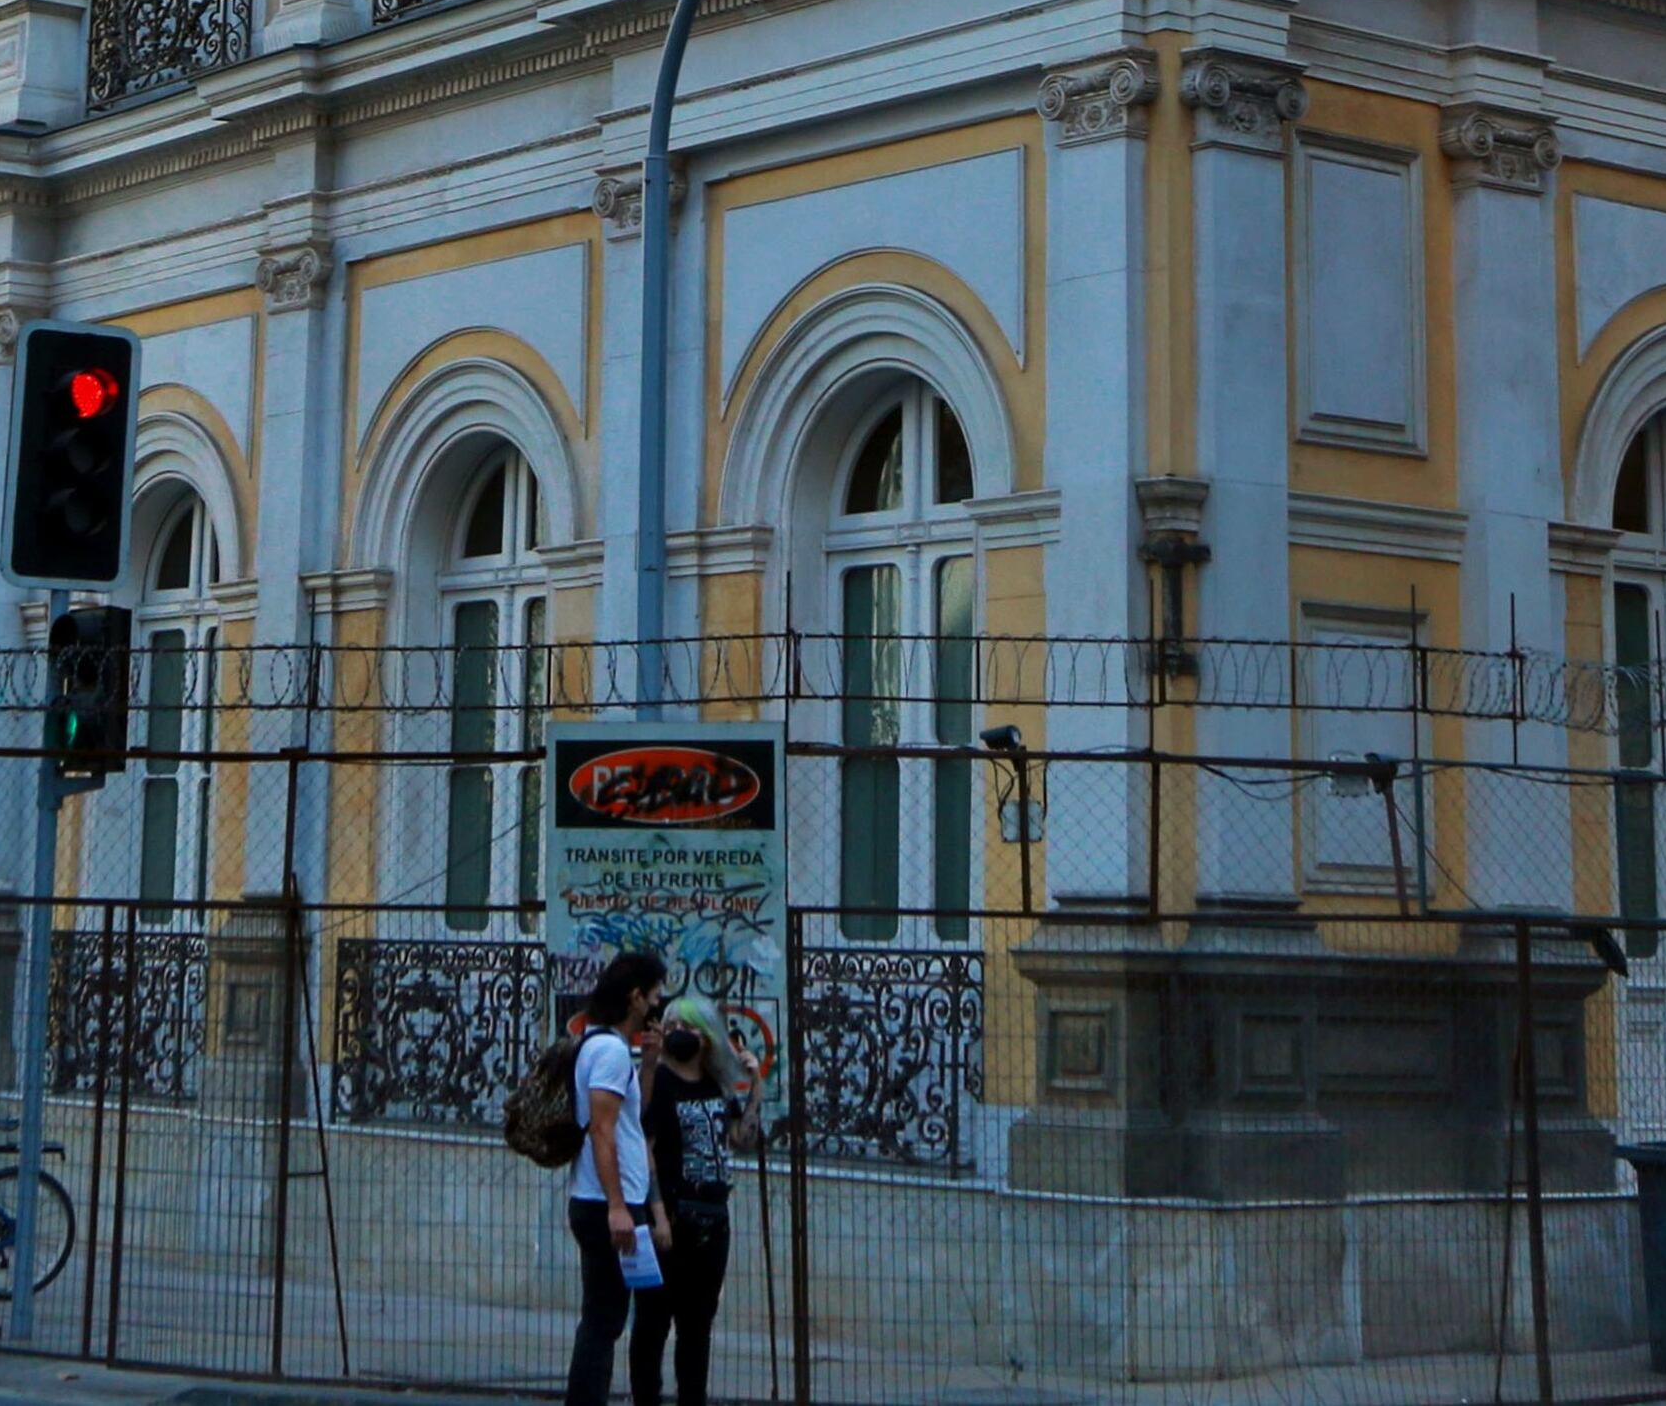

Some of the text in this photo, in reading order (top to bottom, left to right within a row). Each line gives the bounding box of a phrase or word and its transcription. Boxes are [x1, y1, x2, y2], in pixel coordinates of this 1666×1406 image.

[565, 848, 765, 866] TRANSITE POR VEREDA
[603, 872, 725, 888] DE EN FRENTE
